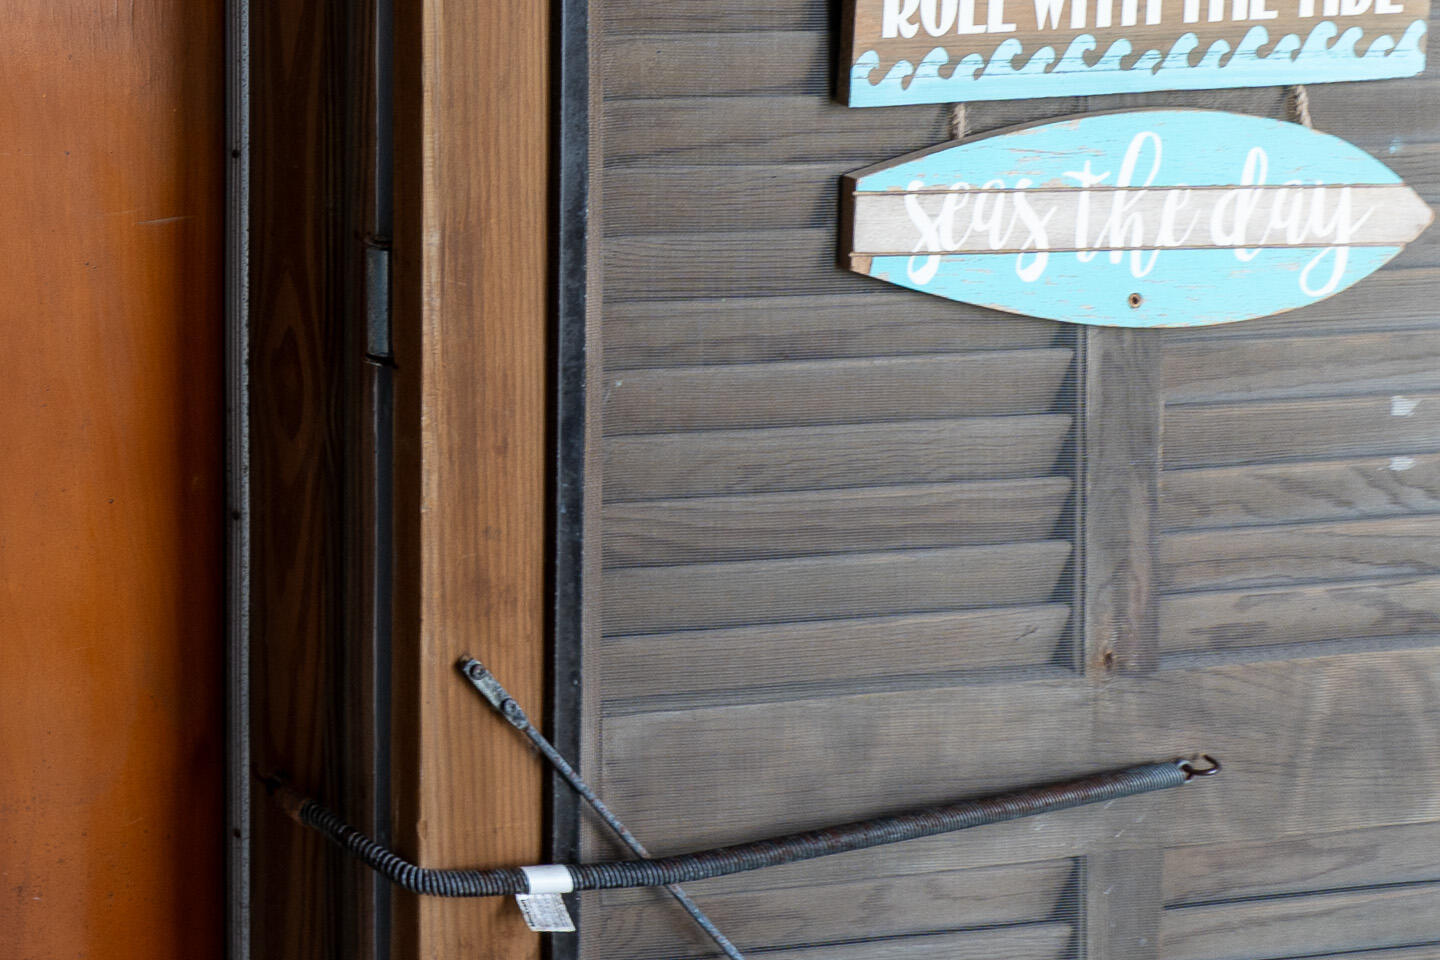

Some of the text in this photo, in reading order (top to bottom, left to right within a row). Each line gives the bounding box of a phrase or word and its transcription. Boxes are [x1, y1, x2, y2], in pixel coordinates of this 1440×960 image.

[902, 131, 1374, 297] seas the day
